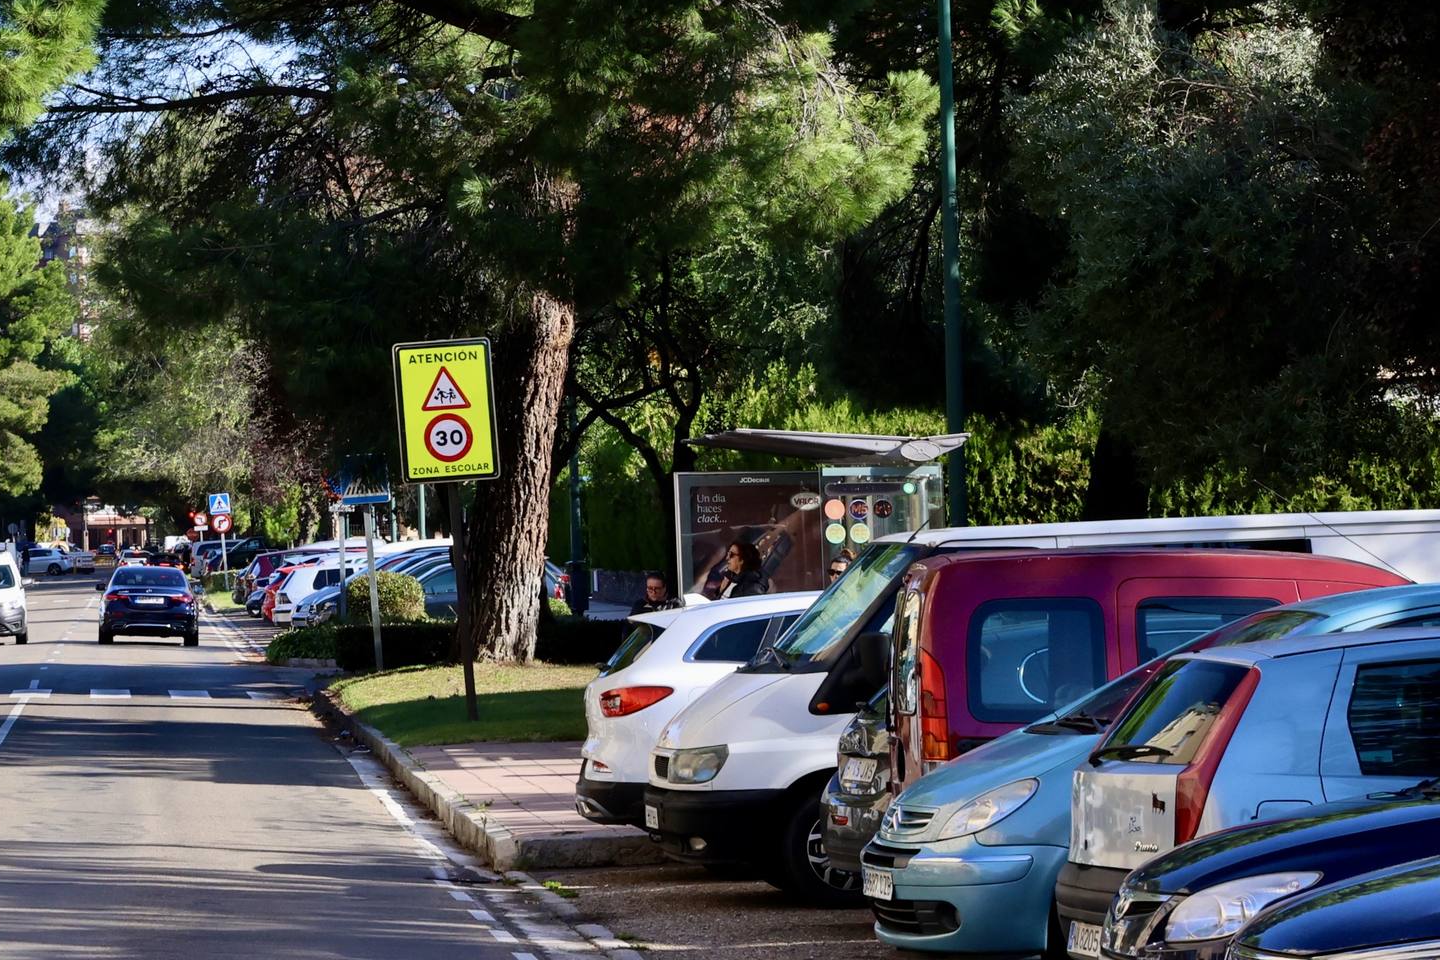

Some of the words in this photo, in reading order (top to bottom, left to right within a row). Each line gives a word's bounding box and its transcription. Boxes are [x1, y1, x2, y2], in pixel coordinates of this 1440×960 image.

[408, 350, 478, 365] ATENCIÓN
[435, 429, 464, 447] 30
[413, 467, 440, 476] ZONA
[445, 462, 489, 473] ESCOLAR
[697, 494, 710, 503] Un
[697, 504, 722, 513] haces
[1134, 841, 1159, 853] Punto
[1079, 928, 1099, 953] 8205
